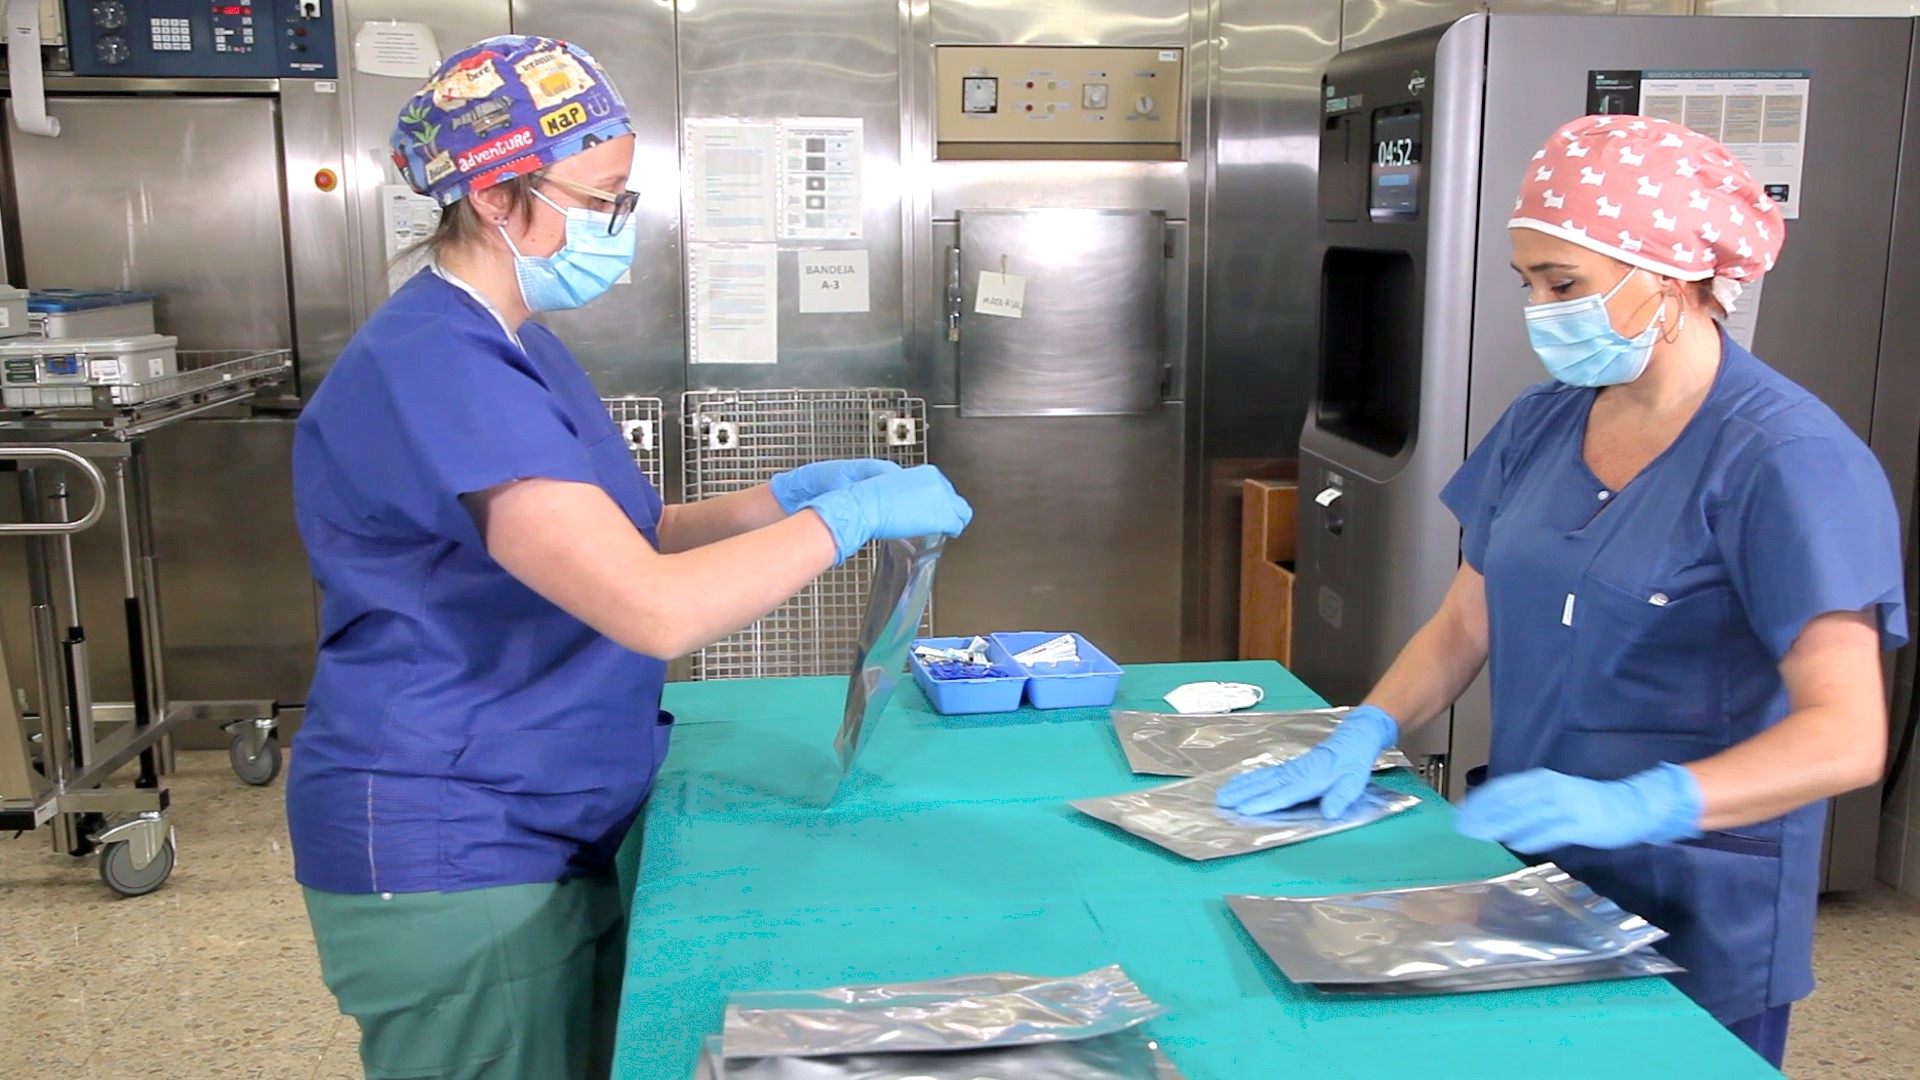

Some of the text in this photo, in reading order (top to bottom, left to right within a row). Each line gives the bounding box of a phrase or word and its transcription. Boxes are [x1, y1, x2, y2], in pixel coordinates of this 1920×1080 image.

[1378, 137, 1412, 168] 04:52
[805, 264, 856, 275] BANDEJA
[821, 280, 840, 290] A-3
